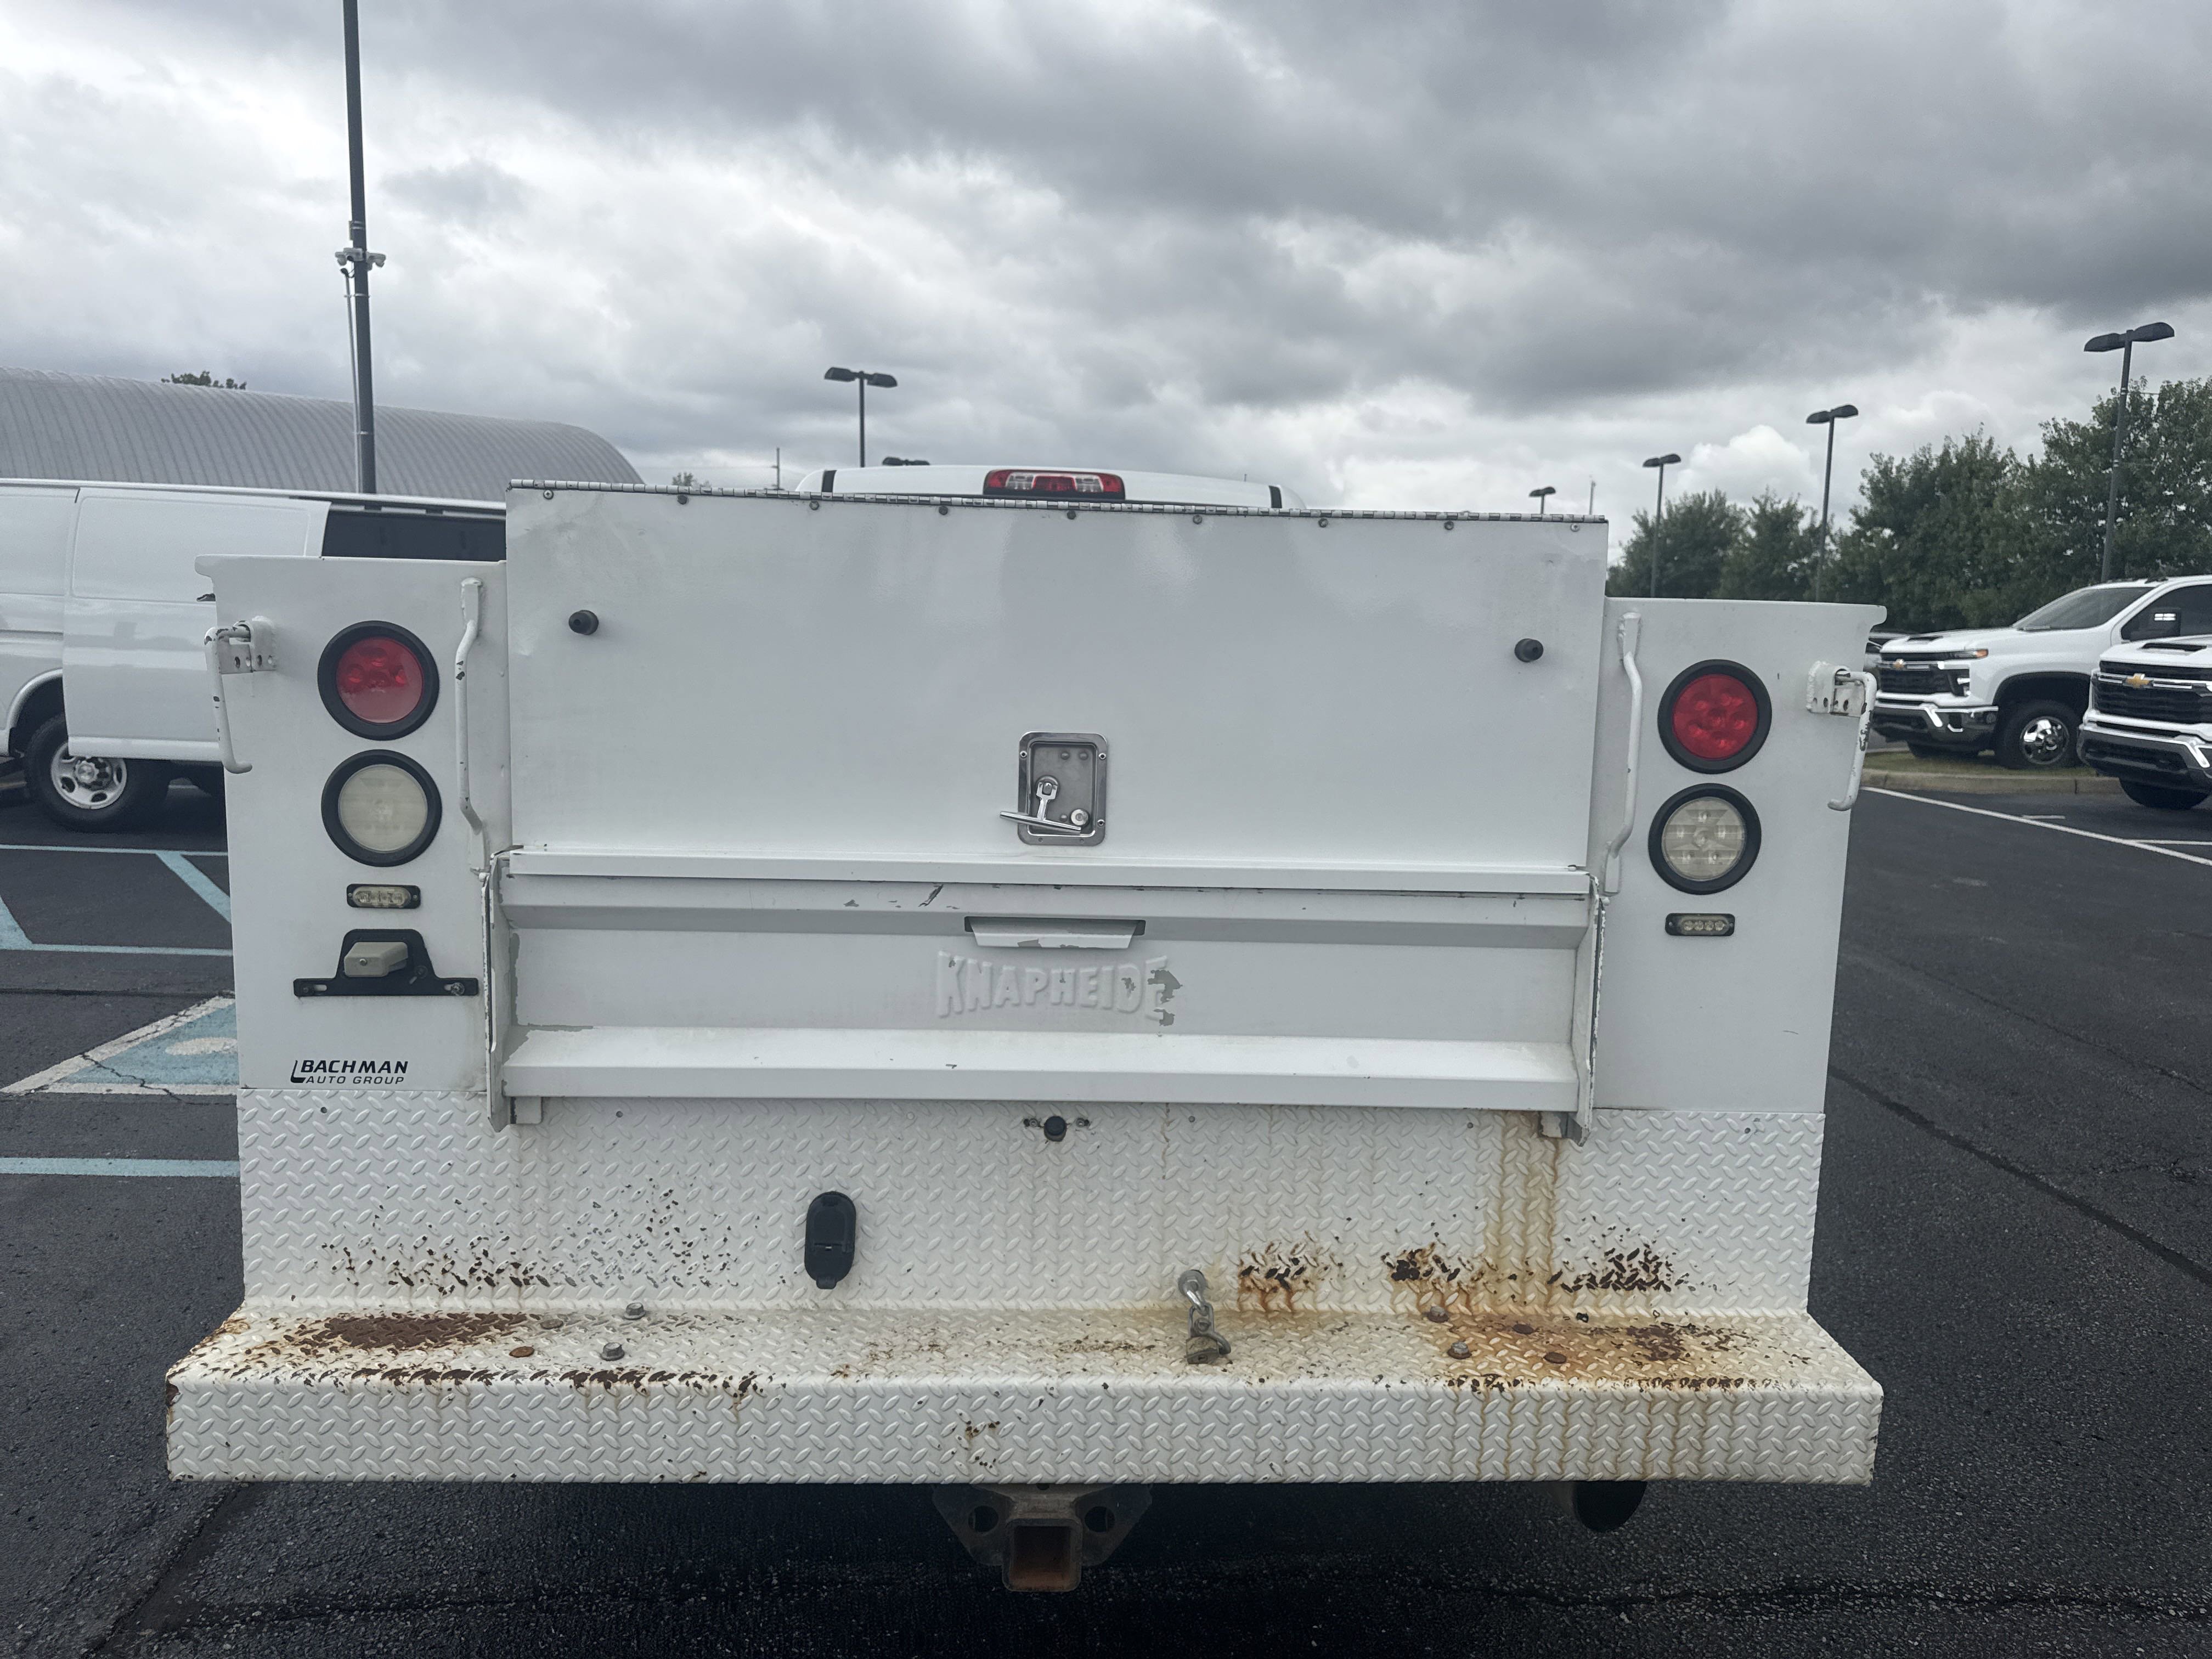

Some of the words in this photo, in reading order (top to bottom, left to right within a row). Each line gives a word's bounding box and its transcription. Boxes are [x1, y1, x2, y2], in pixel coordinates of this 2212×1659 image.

[936, 950, 1172, 1024] KNAPHEIDE
[301, 1059, 408, 1074] BACHMAN
[305, 1075, 346, 1084] AUTO
[352, 1076, 405, 1085] GROUP
